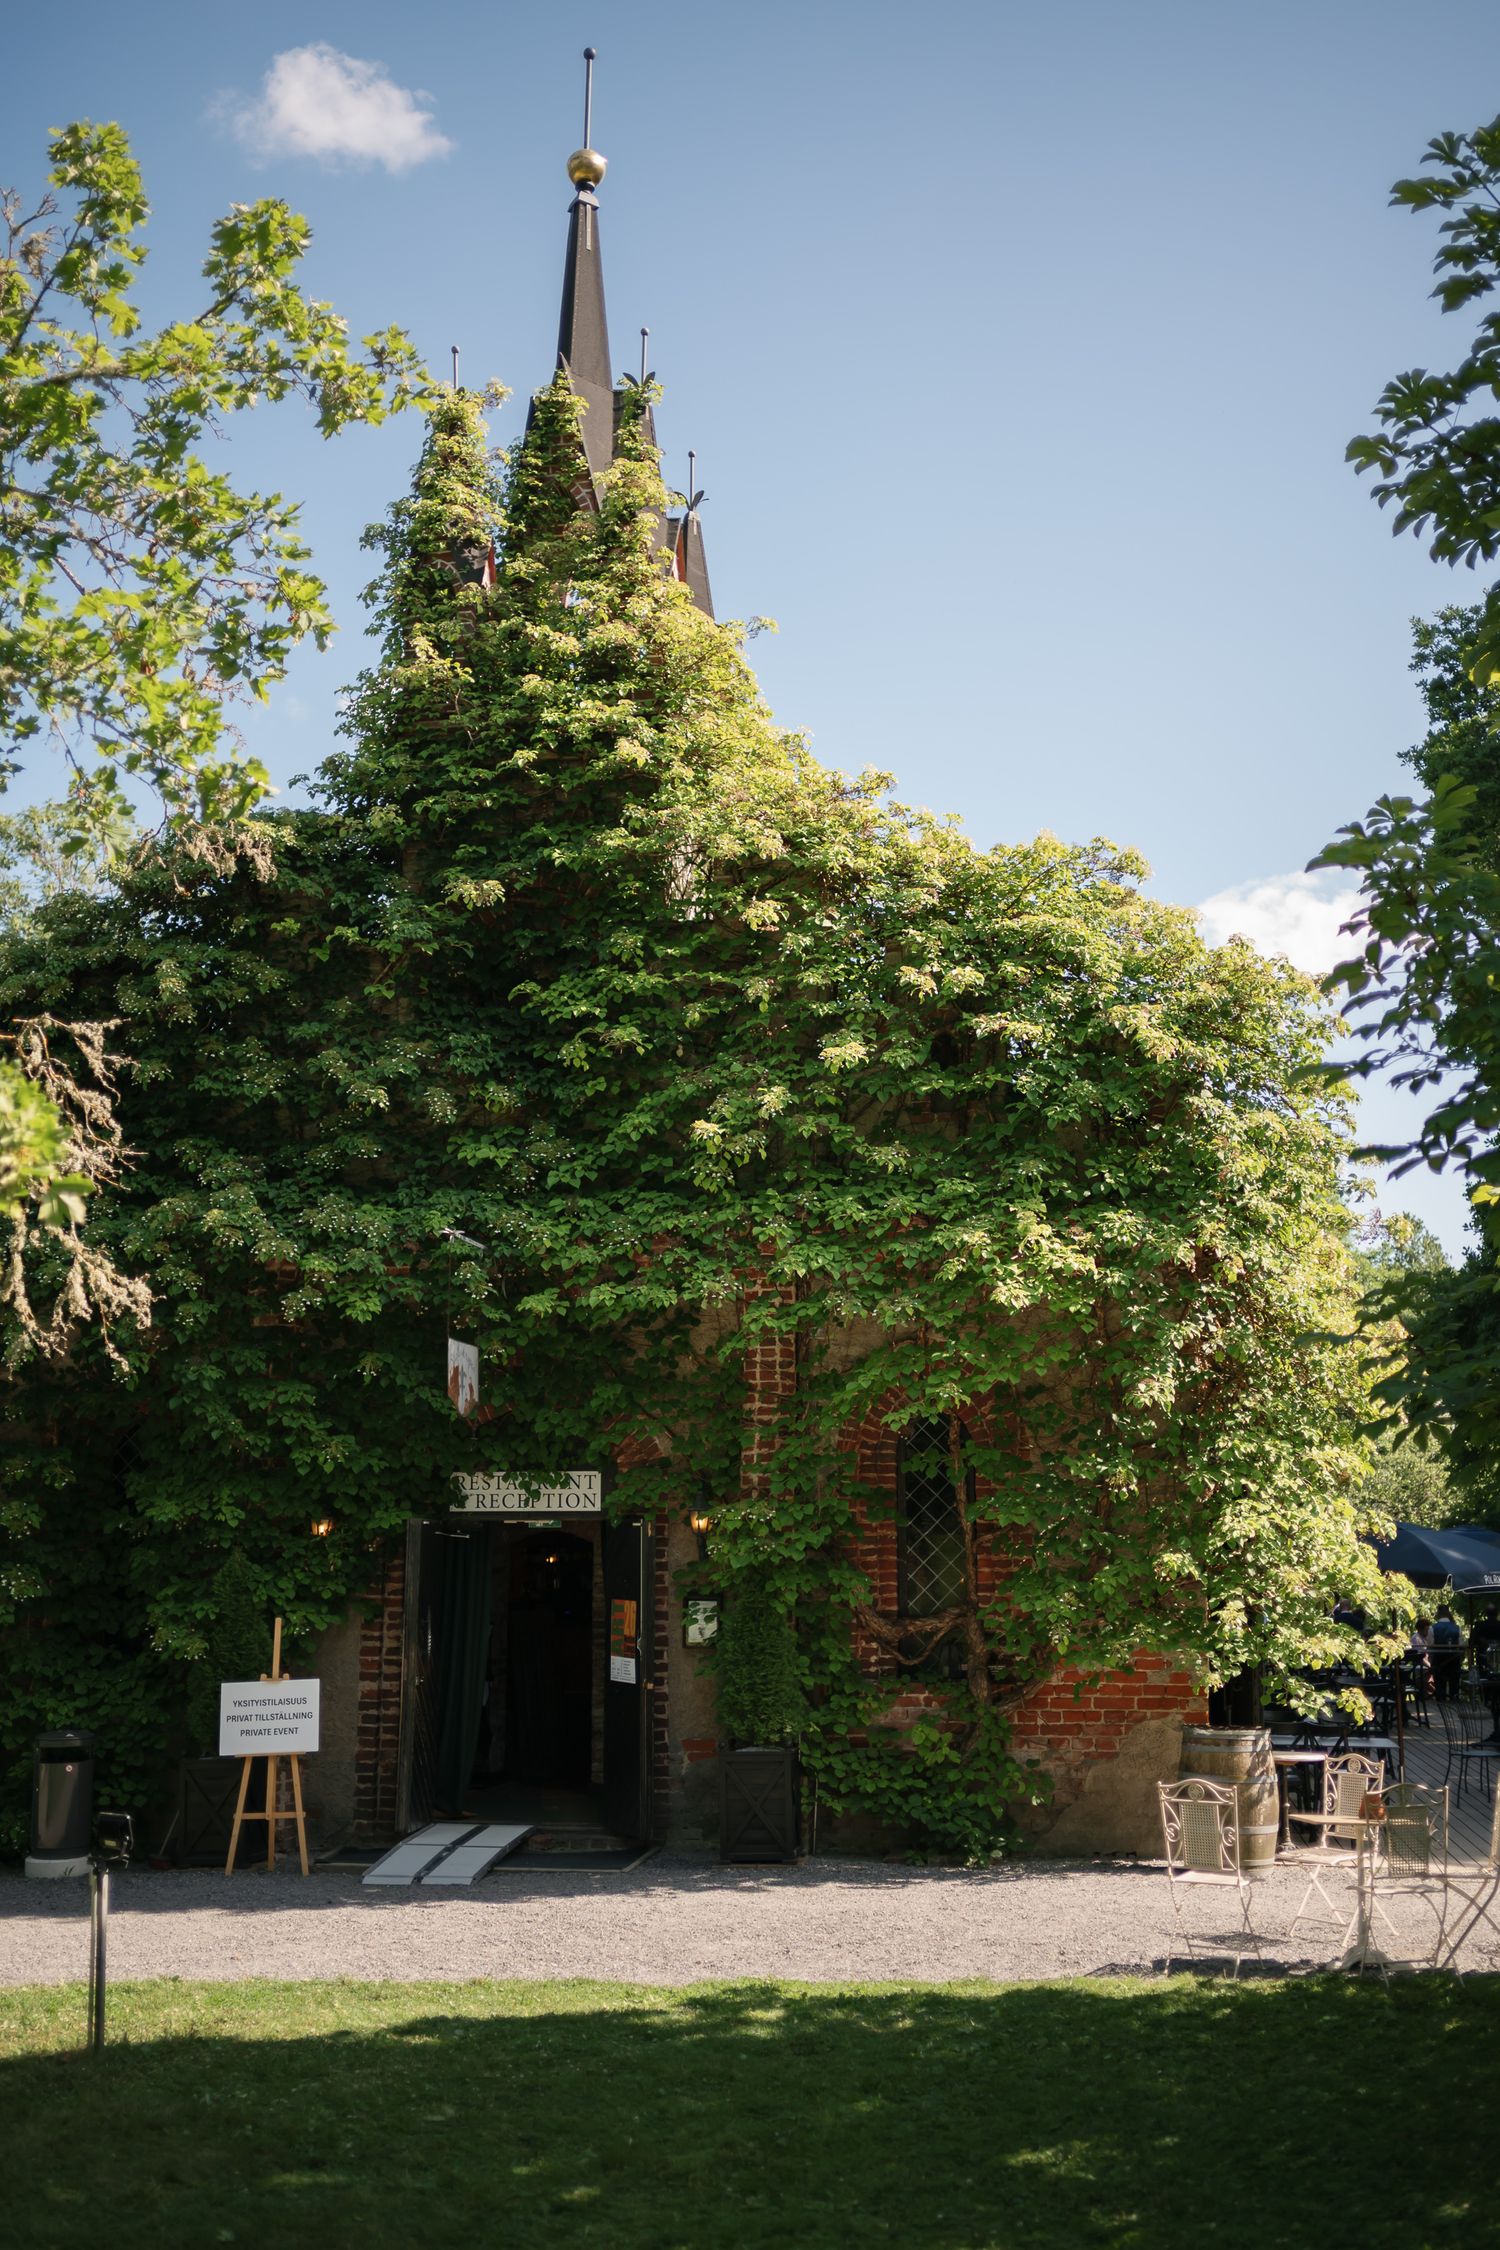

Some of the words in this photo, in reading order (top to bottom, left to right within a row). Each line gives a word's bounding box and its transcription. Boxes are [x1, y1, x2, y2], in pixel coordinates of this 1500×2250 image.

[232, 1697, 308, 1708] YKSITYISTILAISUUS
[226, 1714, 253, 1723] PRIVAT
[254, 1711, 313, 1722] TILLSTÄLLNING
[240, 1728, 272, 1737] PRIVATE
[273, 1726, 299, 1736] EVENT
